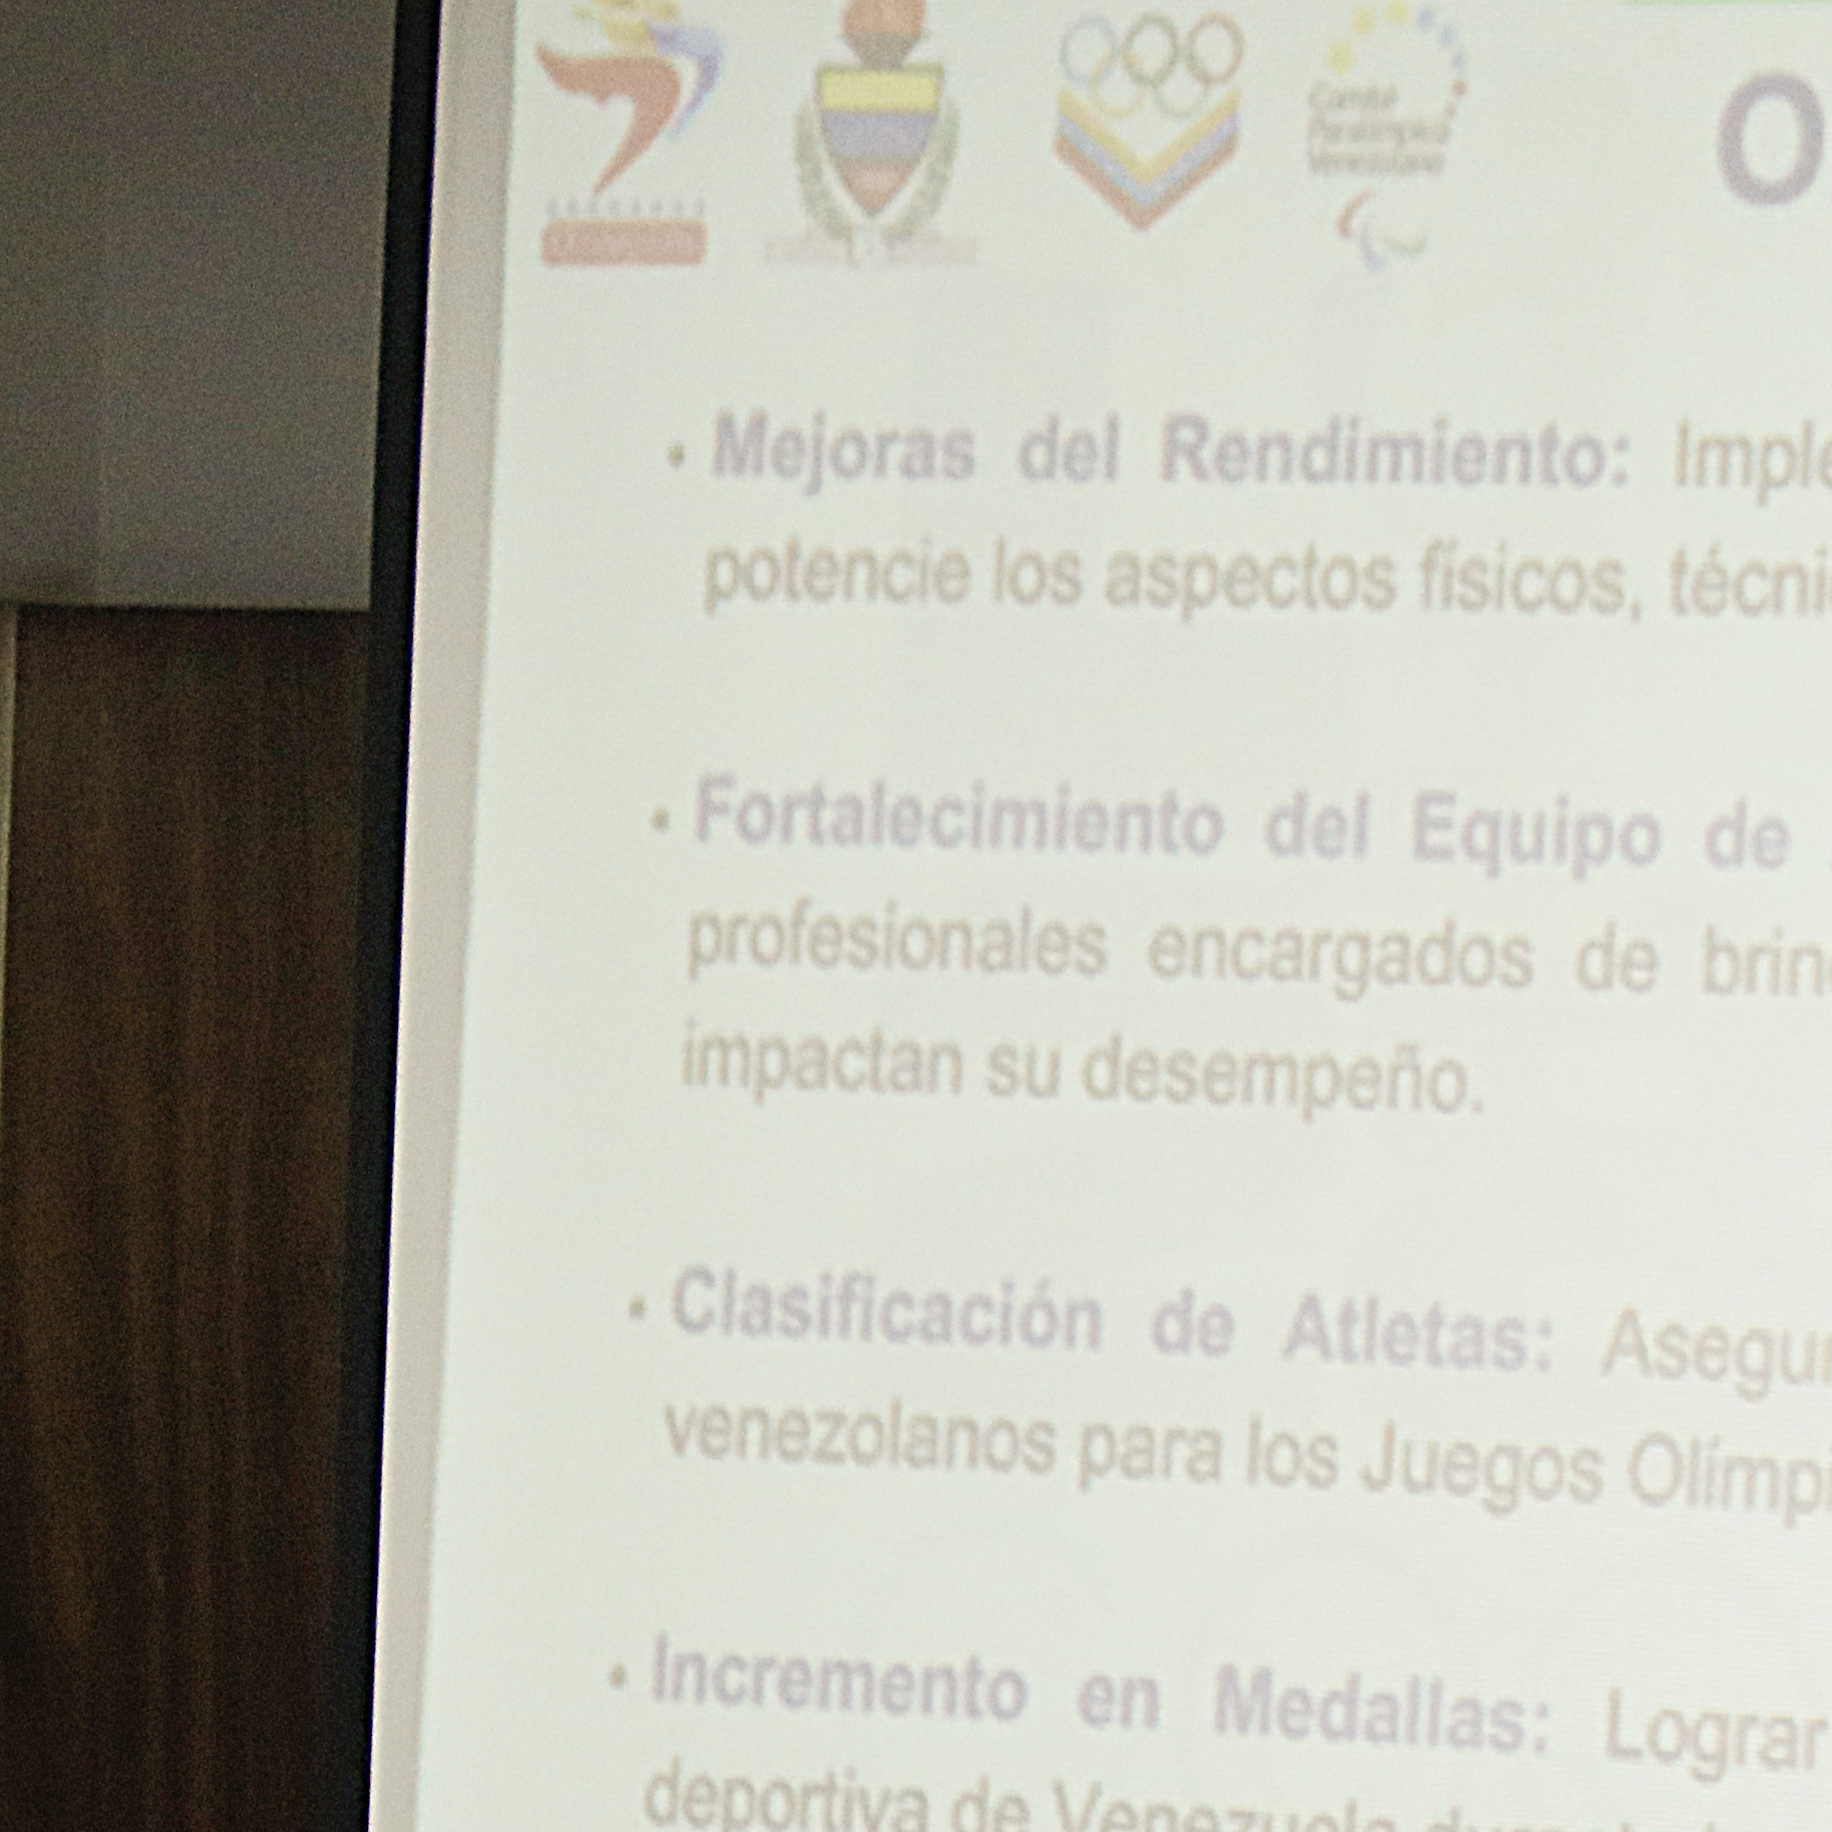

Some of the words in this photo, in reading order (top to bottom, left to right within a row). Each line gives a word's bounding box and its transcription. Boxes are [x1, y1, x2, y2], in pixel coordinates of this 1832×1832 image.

[712, 409, 976, 498] Mejoras
[1018, 413, 1120, 483] del
[1161, 413, 1629, 488] Rendimiento:
[704, 536, 971, 616] potencie
[994, 536, 1083, 606] los
[1104, 543, 1397, 624] aspectos
[1419, 538, 1641, 622] físicos,
[695, 772, 1224, 856] Fortalecimiento
[1265, 790, 1370, 859] del
[1413, 791, 1661, 881] Equipo
[1705, 799, 1789, 870] de
[688, 896, 1108, 982] profesionales
[1148, 918, 1534, 1003] encargados
[1577, 922, 1659, 993] de
[683, 1019, 964, 1105] impactan
[987, 1043, 1061, 1099] su
[1081, 1032, 1482, 1124] desempeño.
[672, 1264, 1102, 1350] Clasificación
[1152, 1287, 1234, 1357] de
[1282, 1293, 1551, 1371] Atletas:
[664, 1398, 1056, 1475] venezolanos
[1078, 1423, 1223, 1493] para
[1247, 1416, 1338, 1489] los
[1360, 1420, 1603, 1517] Juegos
[652, 1632, 1028, 1722] Incremento
[1078, 1674, 1159, 1729] en
[1215, 1664, 1548, 1753] Medallas:
[1606, 1688, 1828, 1784] Lograr
